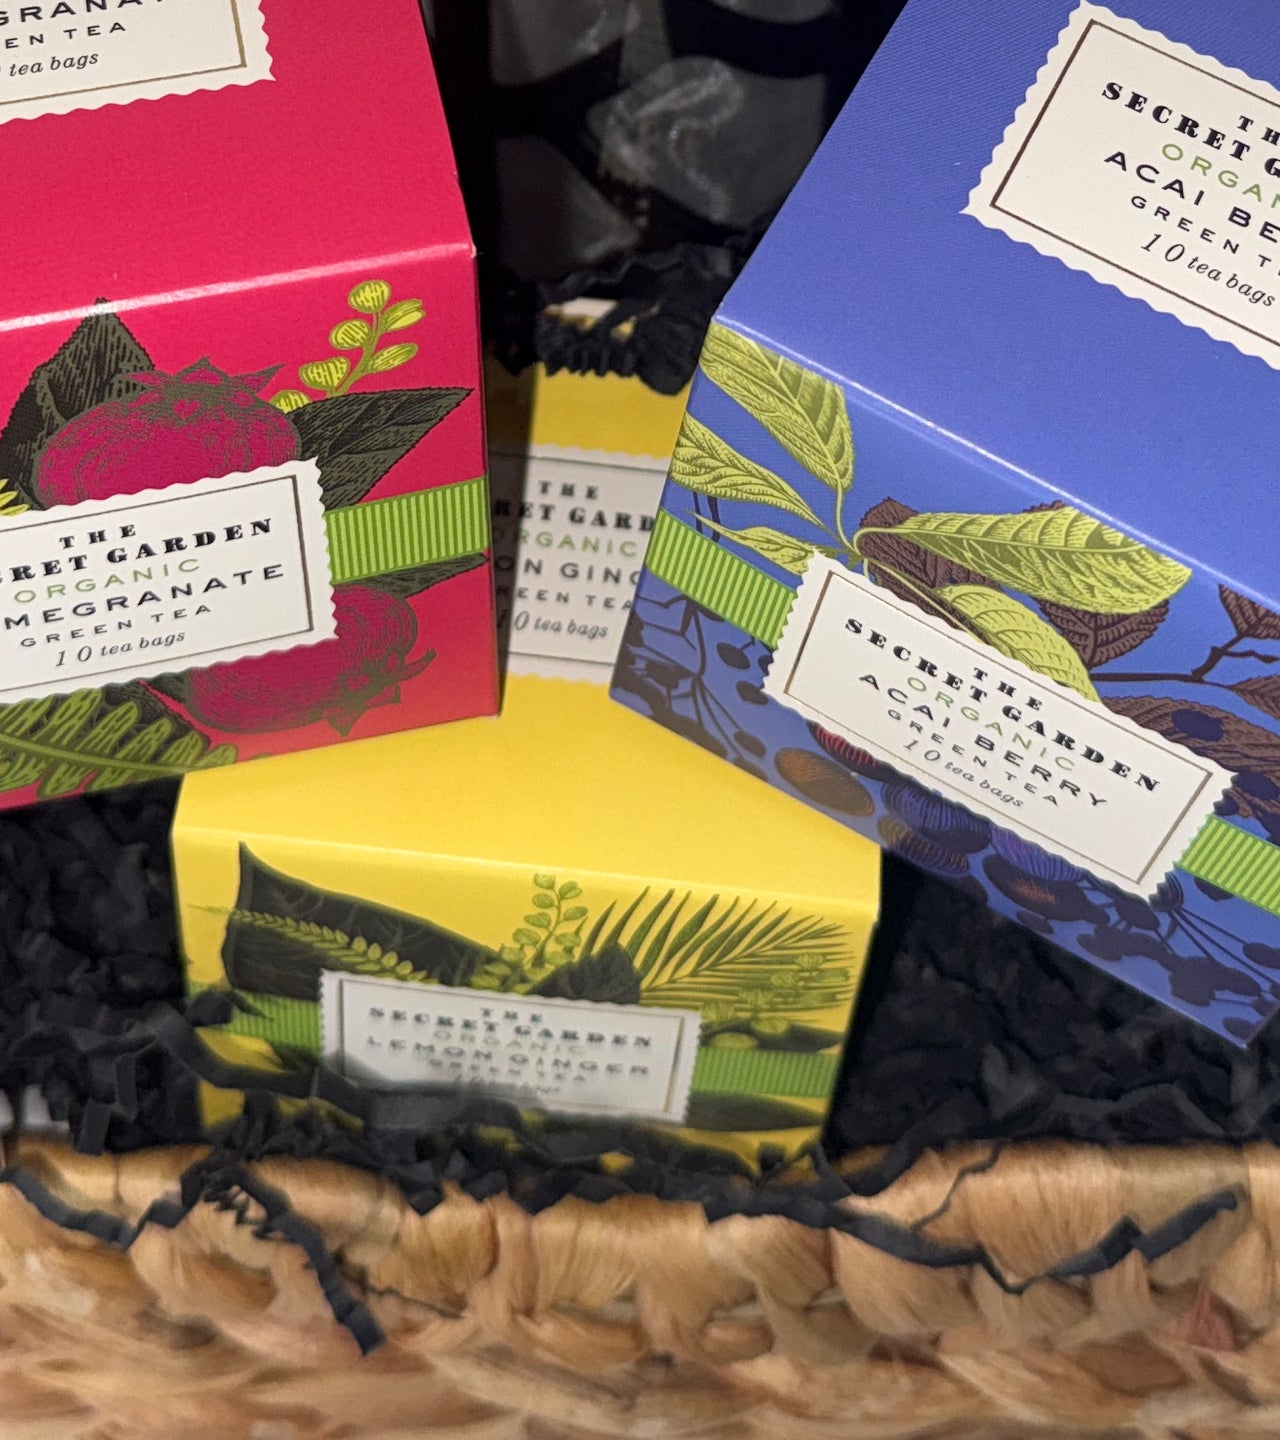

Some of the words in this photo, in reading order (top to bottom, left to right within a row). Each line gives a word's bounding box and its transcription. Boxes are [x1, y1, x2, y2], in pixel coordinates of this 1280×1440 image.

[64, 22, 127, 40] TEA
[8, 56, 43, 78] tea
[49, 51, 100, 76] bags
[1101, 80, 1251, 162] SECRET
[1104, 151, 1206, 207] ACAI
[1130, 195, 1240, 256] GREEN
[1140, 232, 1187, 265] 10
[1187, 252, 1222, 283] tea
[1225, 272, 1277, 309] bags
[538, 480, 600, 500] THE
[59, 524, 137, 550] THE
[107, 517, 273, 563] GARDEN
[569, 507, 656, 532] GARD
[14, 558, 202, 604] ORGANIC
[20, 618, 134, 648] GREEN
[150, 604, 213, 624] TEA
[55, 644, 94, 668] 10
[100, 639, 133, 658] tea
[139, 628, 187, 653] bags
[534, 613, 563, 632] tea
[566, 619, 609, 640] bags
[844, 617, 989, 704] SECRET
[1001, 704, 1162, 793] GARDEN
[972, 667, 1043, 712] THE
[858, 673, 952, 729] ACAI
[974, 735, 1108, 808] BERRY
[907, 676, 1076, 772] ORGANIC
[887, 709, 988, 768] GREEN
[1003, 772, 1059, 807] TEA
[902, 739, 942, 763] 10
[944, 760, 976, 785] tea
[978, 777, 1025, 808] bags
[368, 1006, 500, 1033] SECRET
[514, 1024, 652, 1048] GARDEN
[480, 1008, 544, 1023] THE
[367, 1035, 493, 1062] LEMON
[509, 1052, 649, 1076] GINGER
[433, 1029, 590, 1056] ORGANIC
